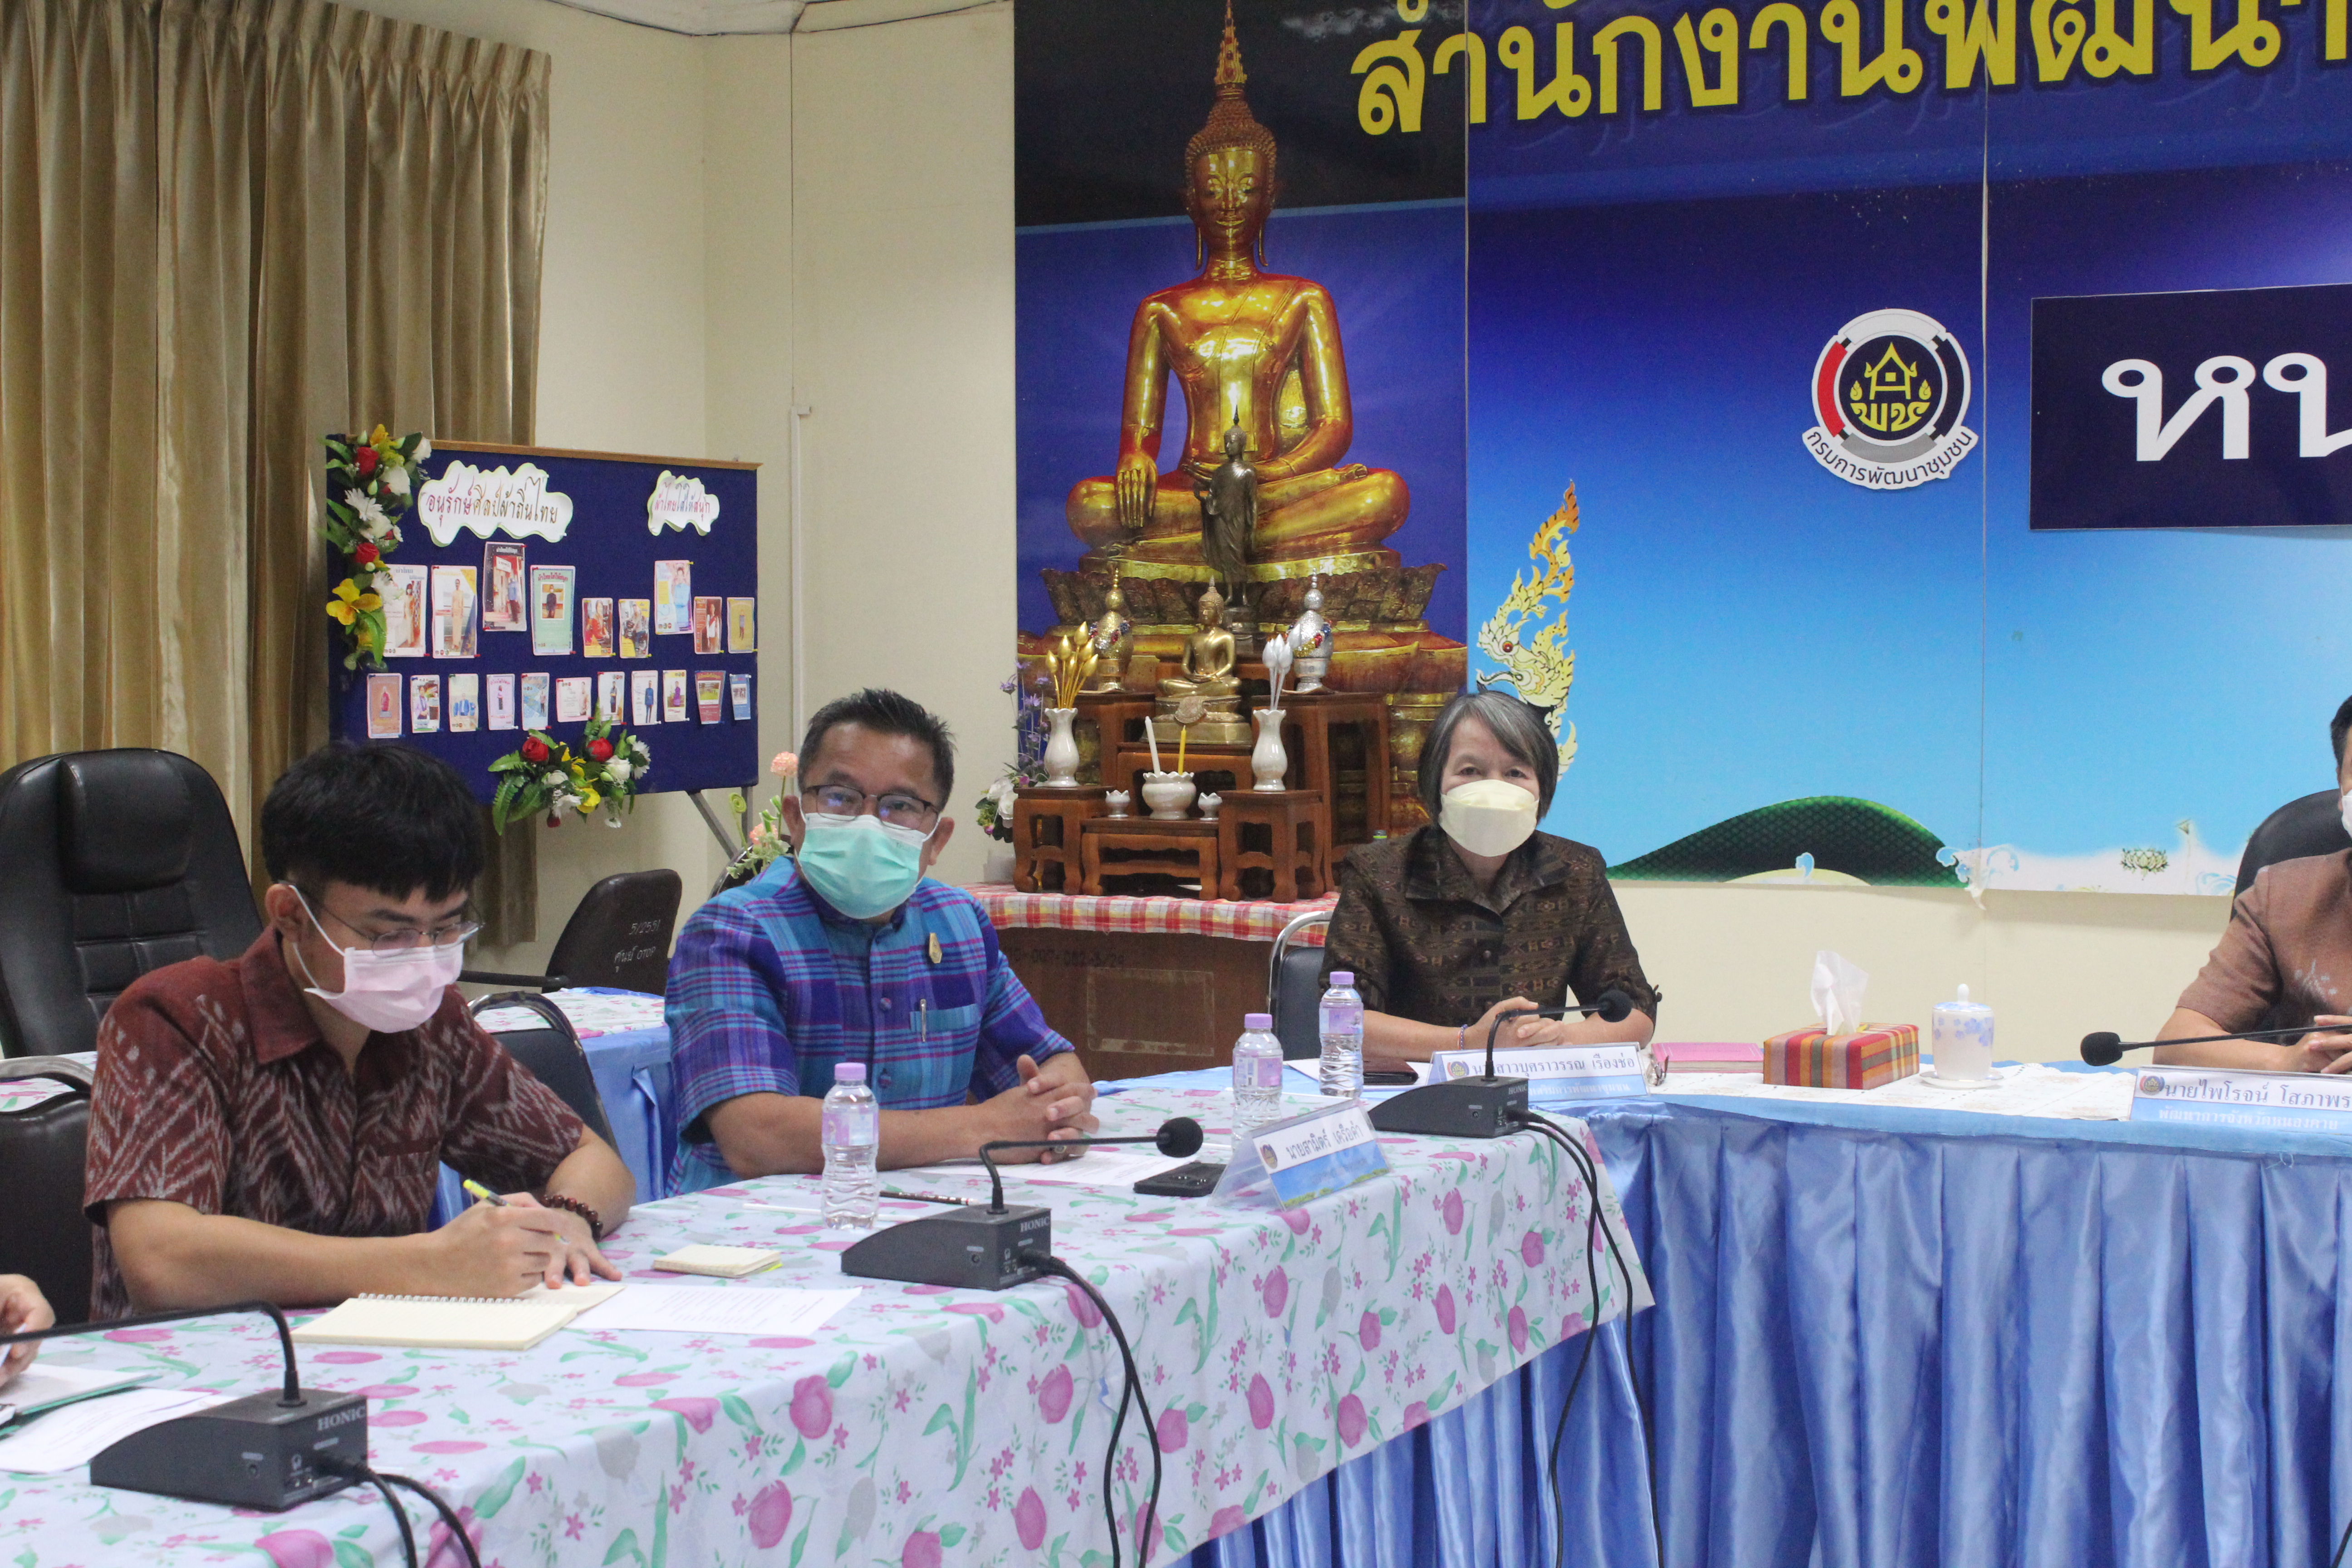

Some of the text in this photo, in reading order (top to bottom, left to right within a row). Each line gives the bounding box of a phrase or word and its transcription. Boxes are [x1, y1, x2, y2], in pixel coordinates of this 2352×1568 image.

[1351, 0, 2347, 135] สำนกงานพฒนา
[1807, 431, 1972, 485] กรมการพัฒนาชุมชน
[637, 946, 656, 960] OTOP
[1472, 1059, 1585, 1076] นสาวบุศราวรรณ
[2164, 1078, 2269, 1103] นายไพโรจน์
[1020, 1216, 1049, 1233] HONIC
[318, 1406, 366, 1431] HONIC
